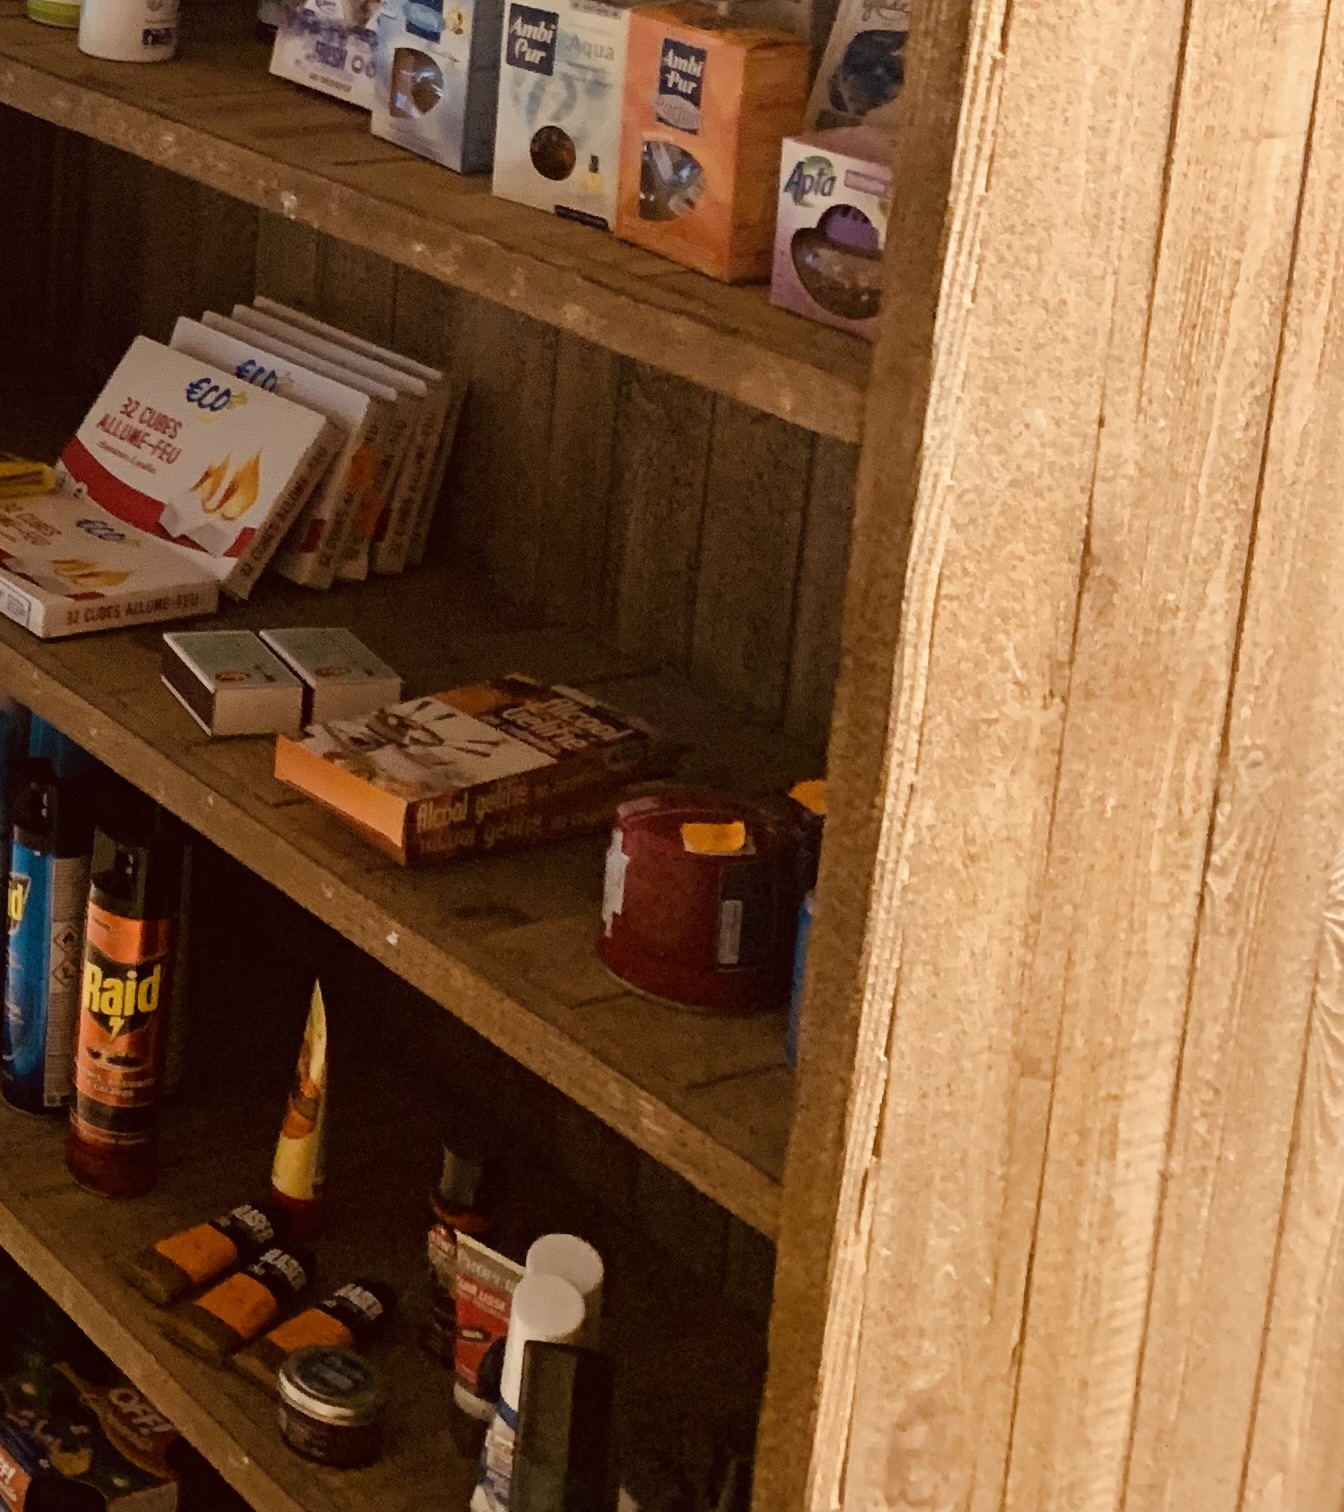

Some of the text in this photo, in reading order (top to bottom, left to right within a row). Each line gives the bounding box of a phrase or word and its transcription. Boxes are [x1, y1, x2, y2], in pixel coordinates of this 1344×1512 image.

[510, 16, 557, 45] Ambi
[514, 38, 547, 65] Pur
[664, 48, 703, 78] Ambi
[665, 69, 698, 95] Pur
[783, 161, 837, 206] Apta
[95, 413, 183, 465] ALLUME-FEU
[119, 396, 183, 439] 32 CUBES
[83, 961, 162, 1017] Raid
[108, 1388, 175, 1436] OFF!
